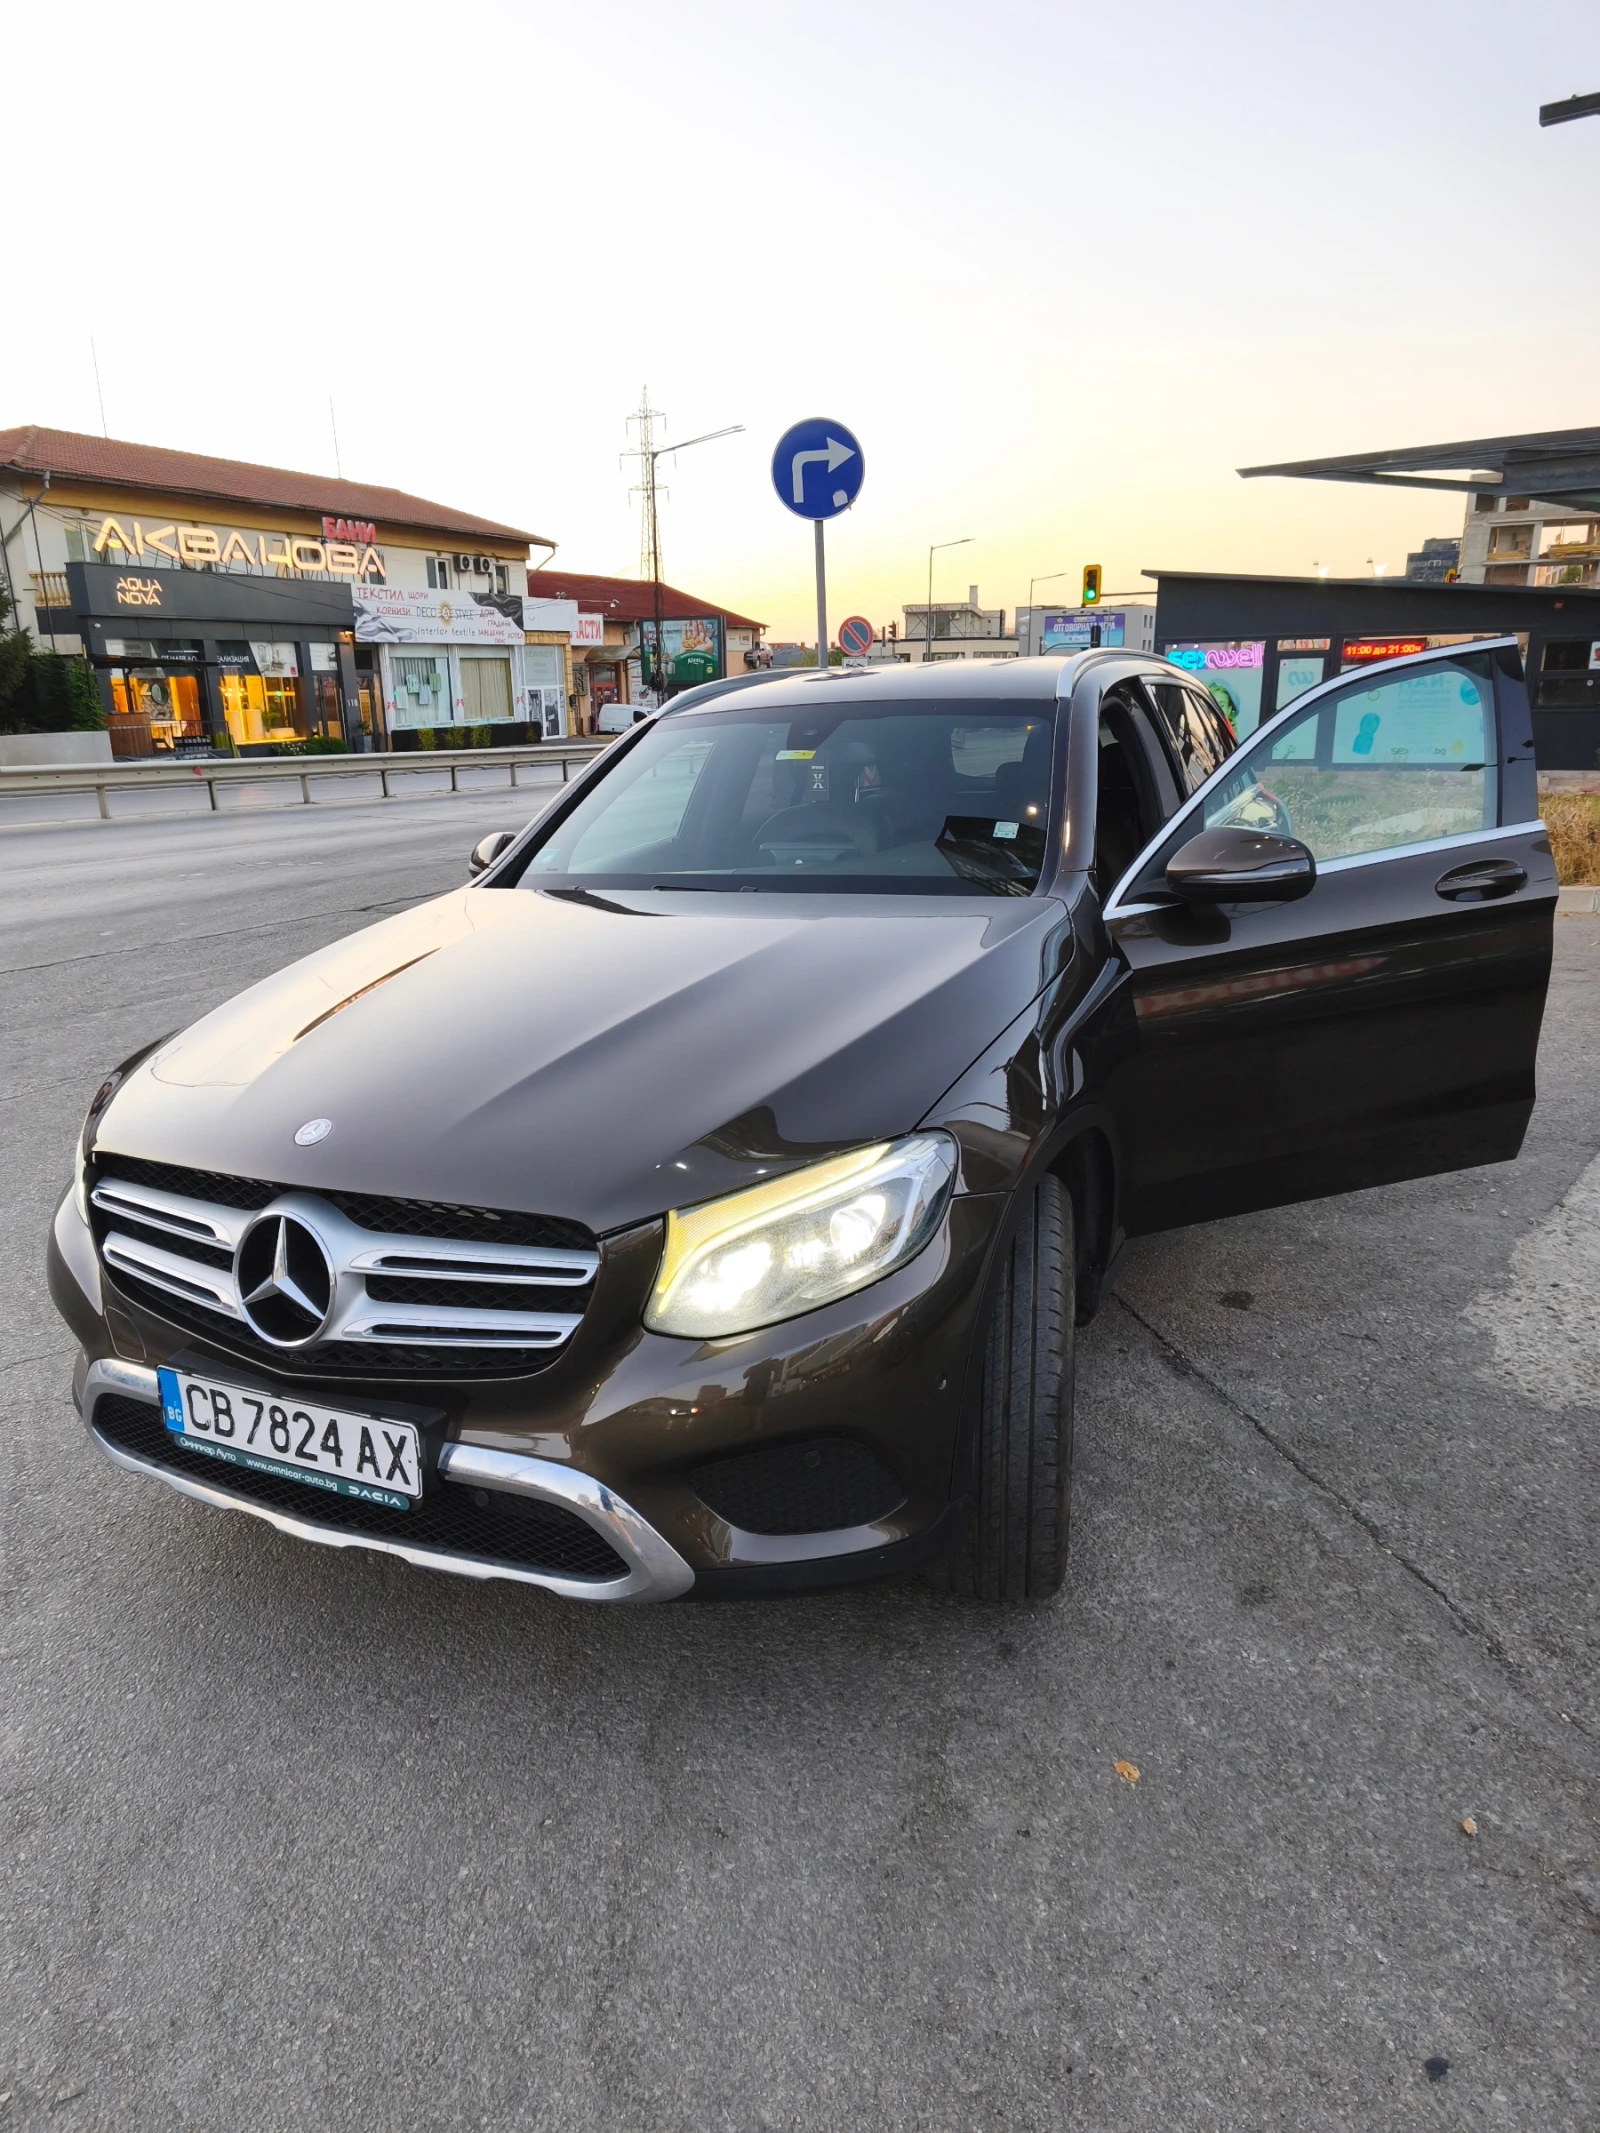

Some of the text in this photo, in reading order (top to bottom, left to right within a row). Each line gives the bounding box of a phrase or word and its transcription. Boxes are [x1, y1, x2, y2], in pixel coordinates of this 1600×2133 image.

[322, 516, 377, 545] БАНИ
[93, 517, 386, 577] АКВАНОВА
[116, 576, 163, 592] AQUA
[116, 587, 162, 606] NOVA
[356, 586, 429, 602] ТЕКСТИЛ ЩОРИ
[376, 606, 411, 616] КОРНИЗИ
[416, 606, 437, 618] DECO
[455, 609, 474, 620] STYLE
[487, 619, 512, 628] ГРАДИНА
[1053, 621, 1098, 632] ОТГОВОРНАТ
[451, 627, 476, 637] textile
[1346, 646, 1373, 655] 11:00
[1373, 646, 1387, 655] до
[167, 1405, 183, 1423] BG
[185, 1384, 412, 1486] CB 7824 AX
[246, 1457, 338, 1491] www.omnicar-auto.bg
[348, 1485, 402, 1507] DACIA
